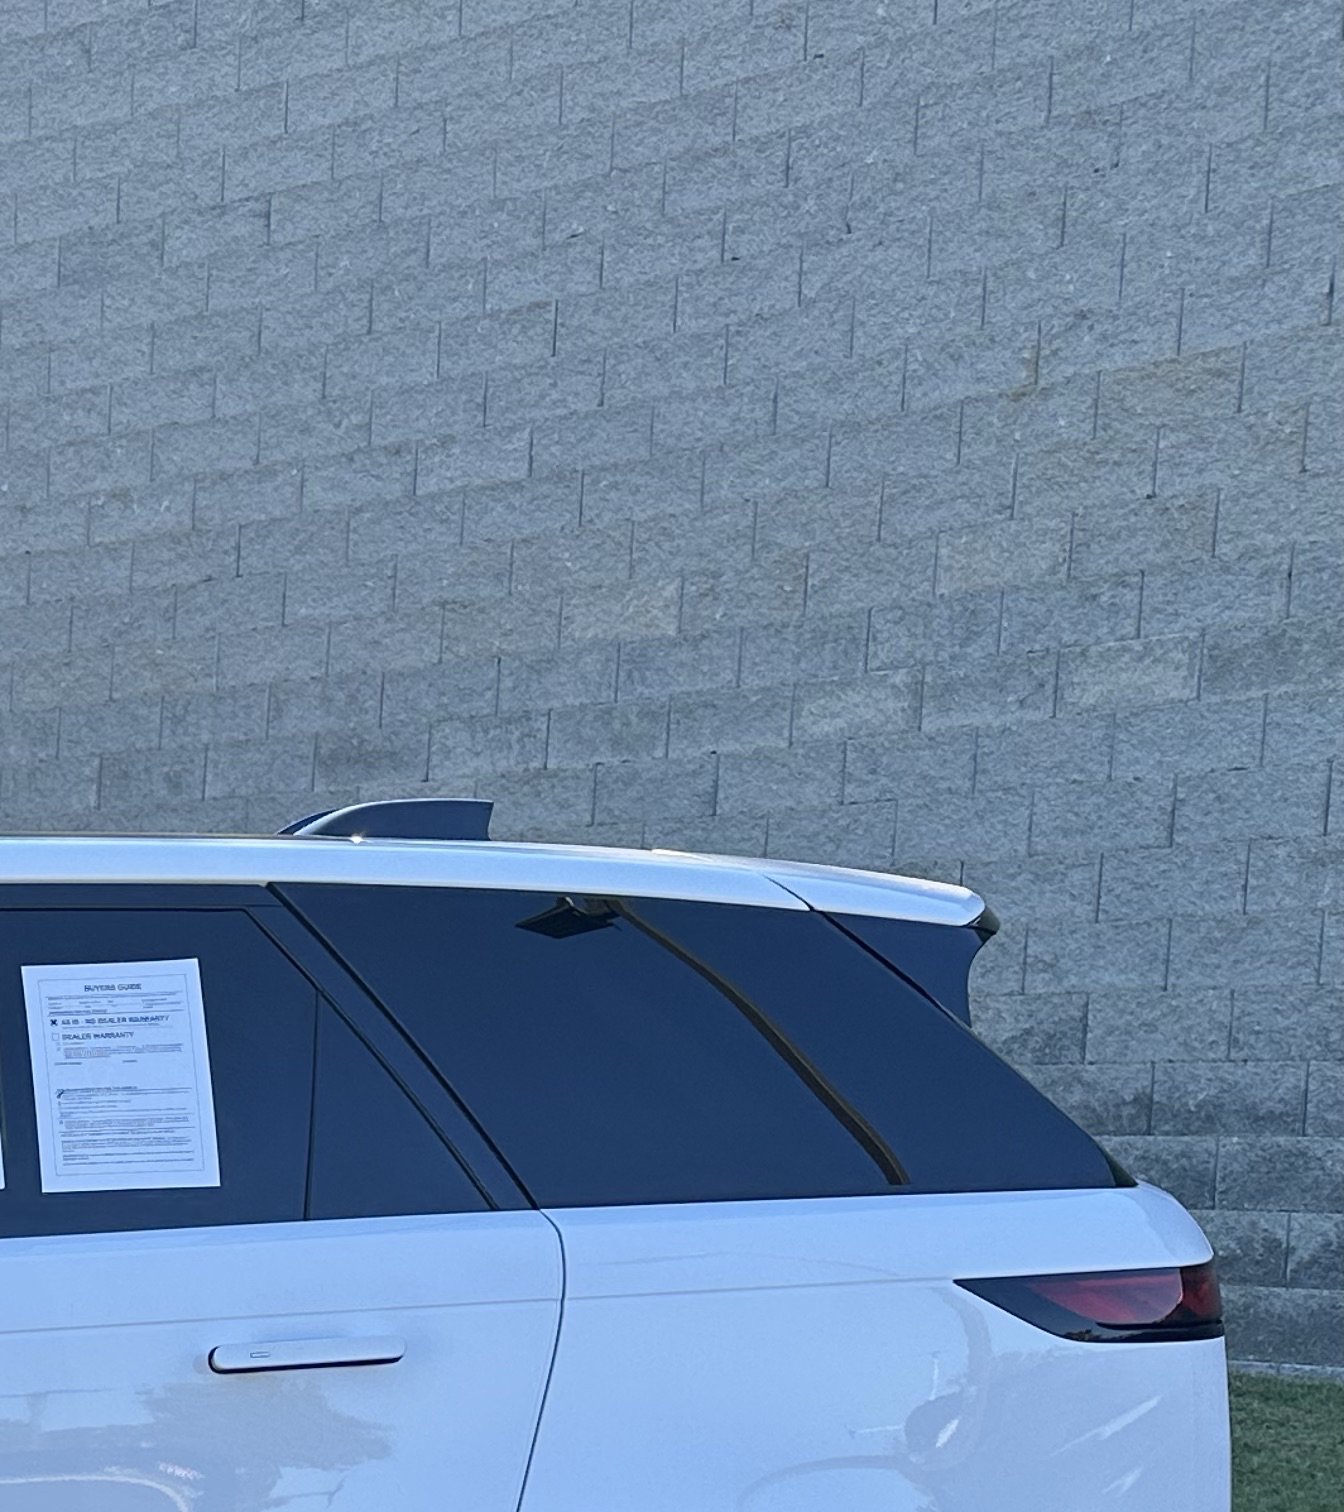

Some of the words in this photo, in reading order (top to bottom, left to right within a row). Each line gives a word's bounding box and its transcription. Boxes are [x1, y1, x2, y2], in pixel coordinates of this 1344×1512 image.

[84, 984, 116, 992] BUYERS
[117, 983, 142, 991] GUIDE
[62, 1033, 92, 1041] DEALER
[93, 1031, 135, 1039] WARRANTY
